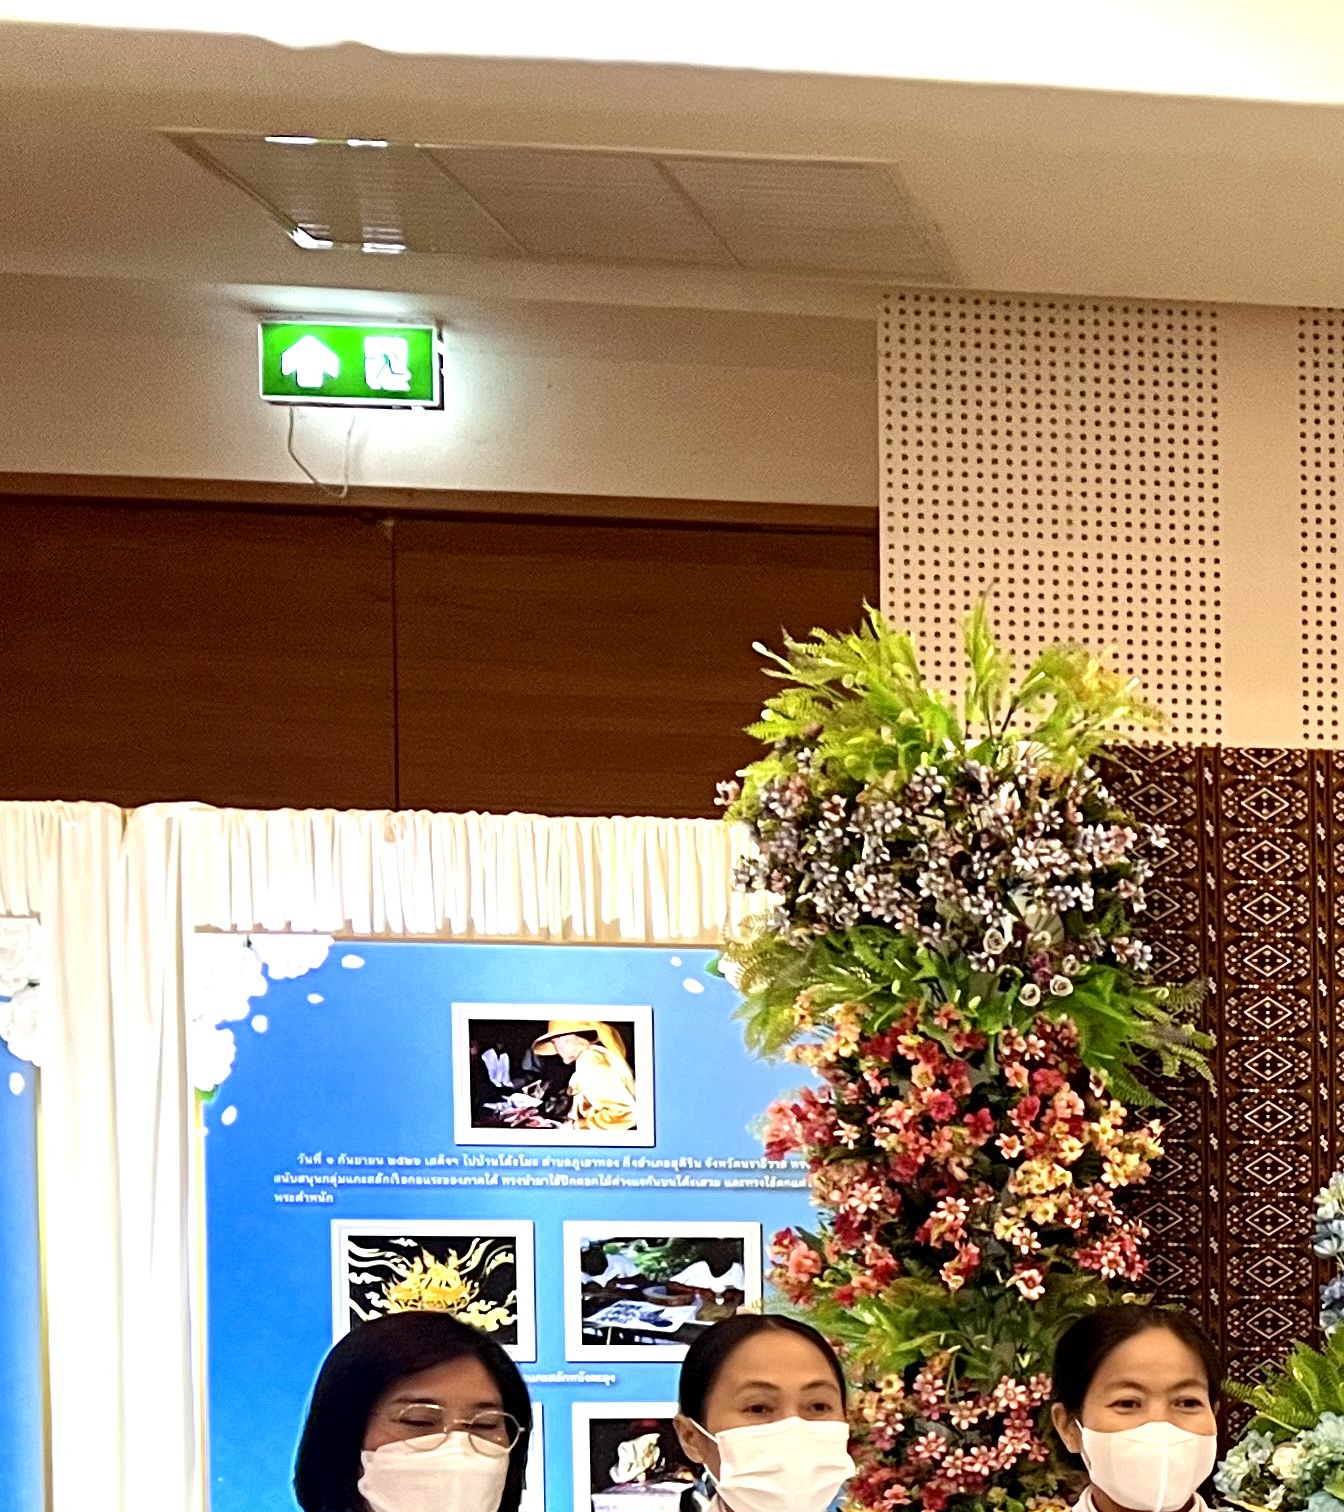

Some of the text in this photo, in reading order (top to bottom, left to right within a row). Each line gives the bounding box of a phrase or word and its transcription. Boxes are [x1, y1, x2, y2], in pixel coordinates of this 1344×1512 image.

[298, 1151, 322, 1165] วันที่
[337, 1153, 384, 1165] กันยายน
[274, 1191, 334, 1203] พระตำหนัก
